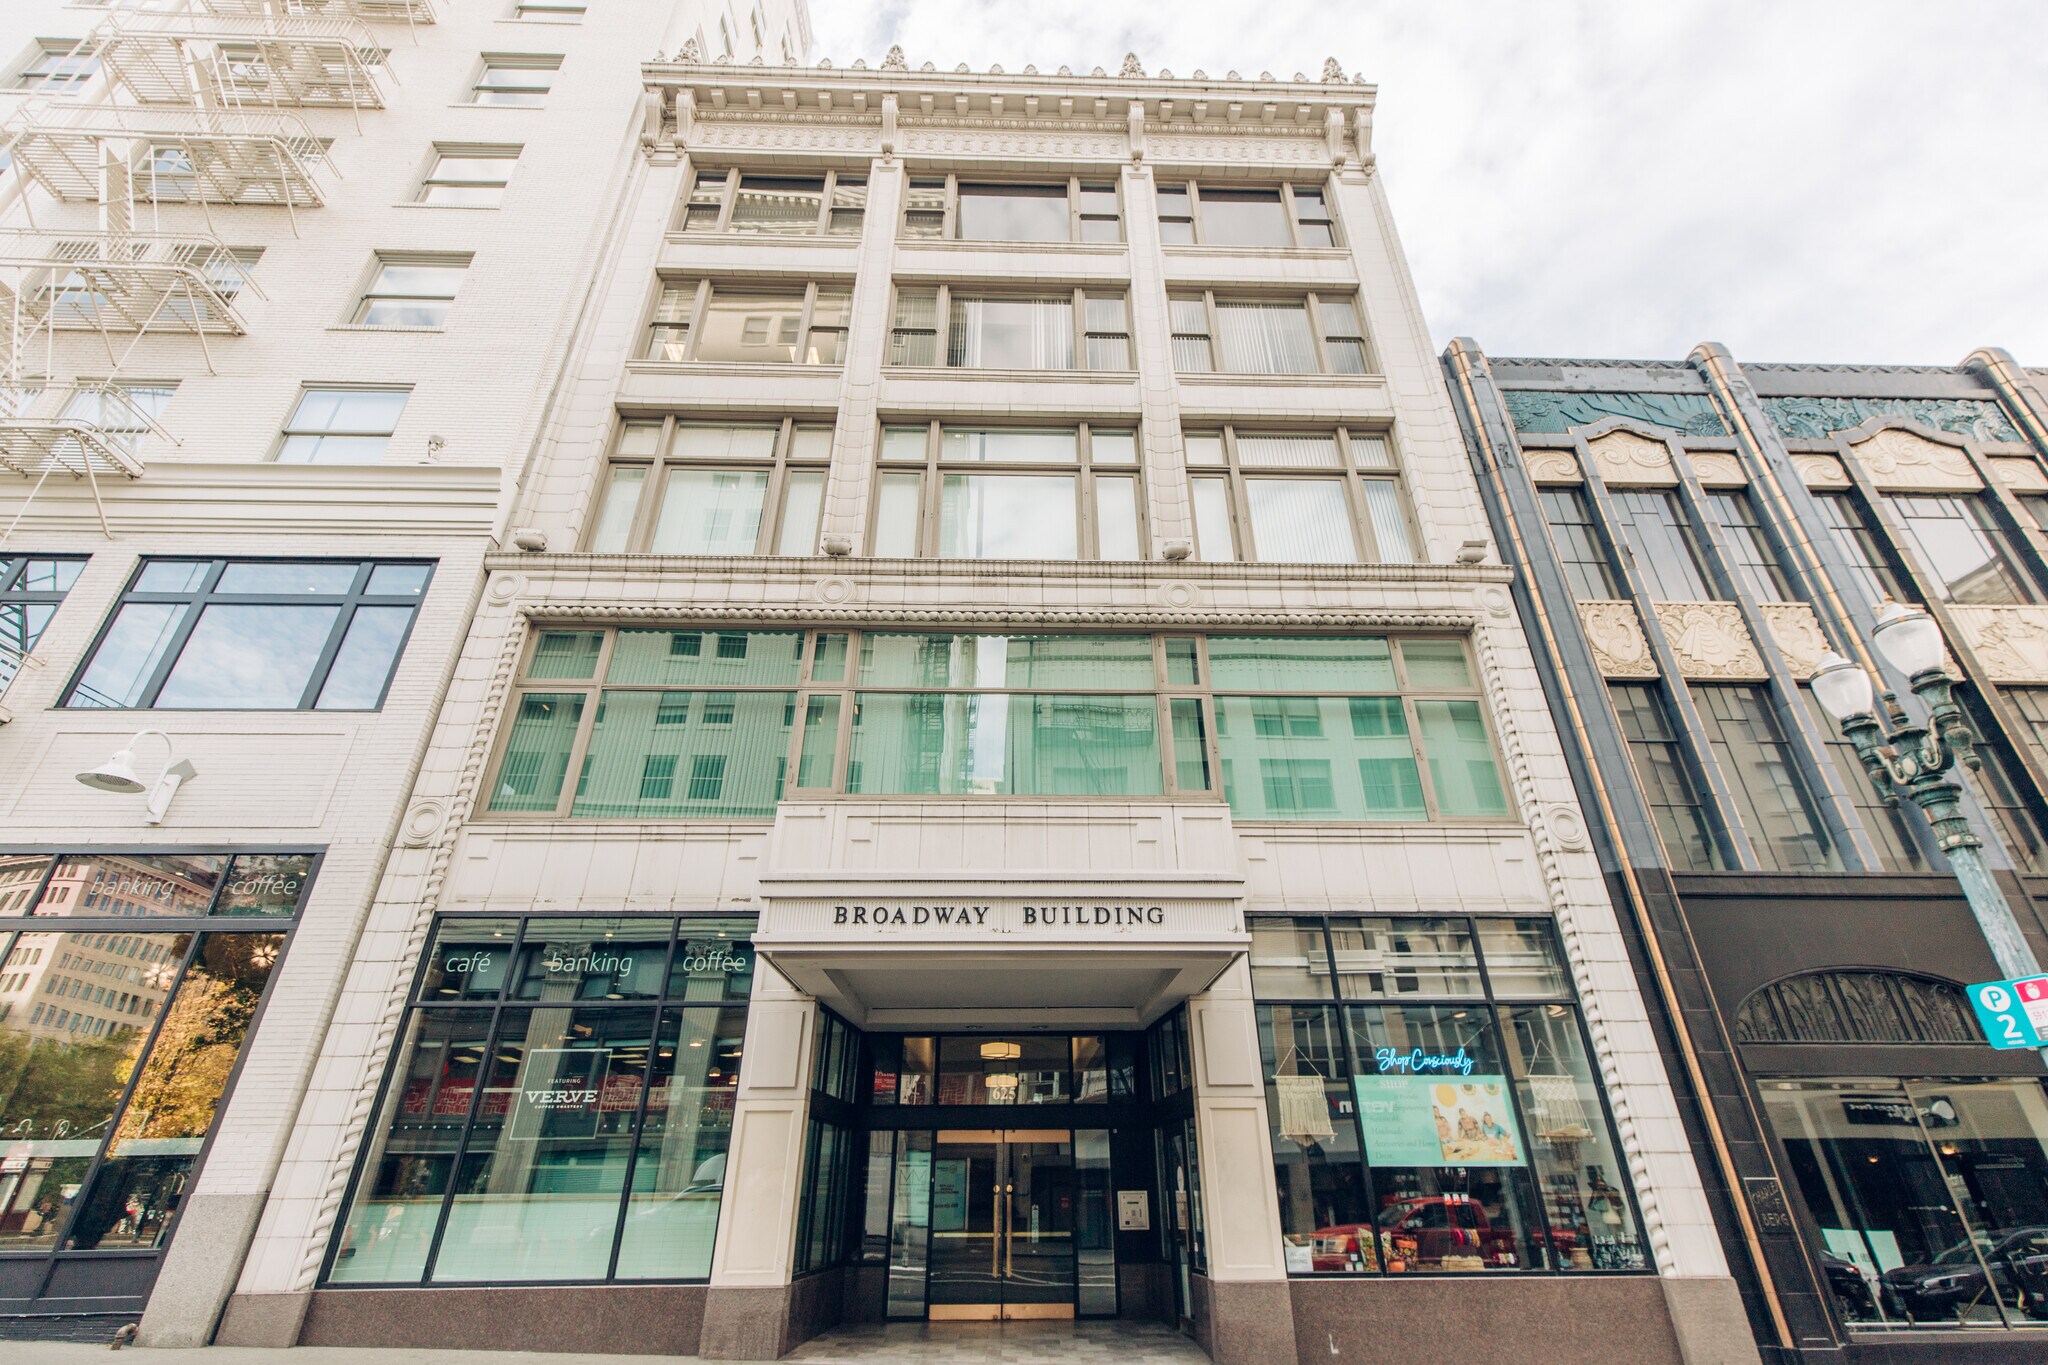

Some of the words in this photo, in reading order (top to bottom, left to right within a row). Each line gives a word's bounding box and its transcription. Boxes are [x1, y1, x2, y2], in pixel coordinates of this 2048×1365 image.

[89, 875, 176, 899] banking
[232, 875, 297, 895] coffee
[833, 906, 989, 924] BROADWAY
[1023, 906, 1164, 924] BUILDING
[446, 951, 491, 973] café
[550, 952, 632, 977] banking
[683, 951, 746, 973] coffee
[1987, 990, 2002, 1007] P
[1996, 1014, 2023, 1038] 2
[1376, 1047, 1411, 1074] Shop
[525, 1089, 598, 1103] VERVE
[992, 1086, 1016, 1100] 625
[1761, 1212, 1789, 1226] BERG
